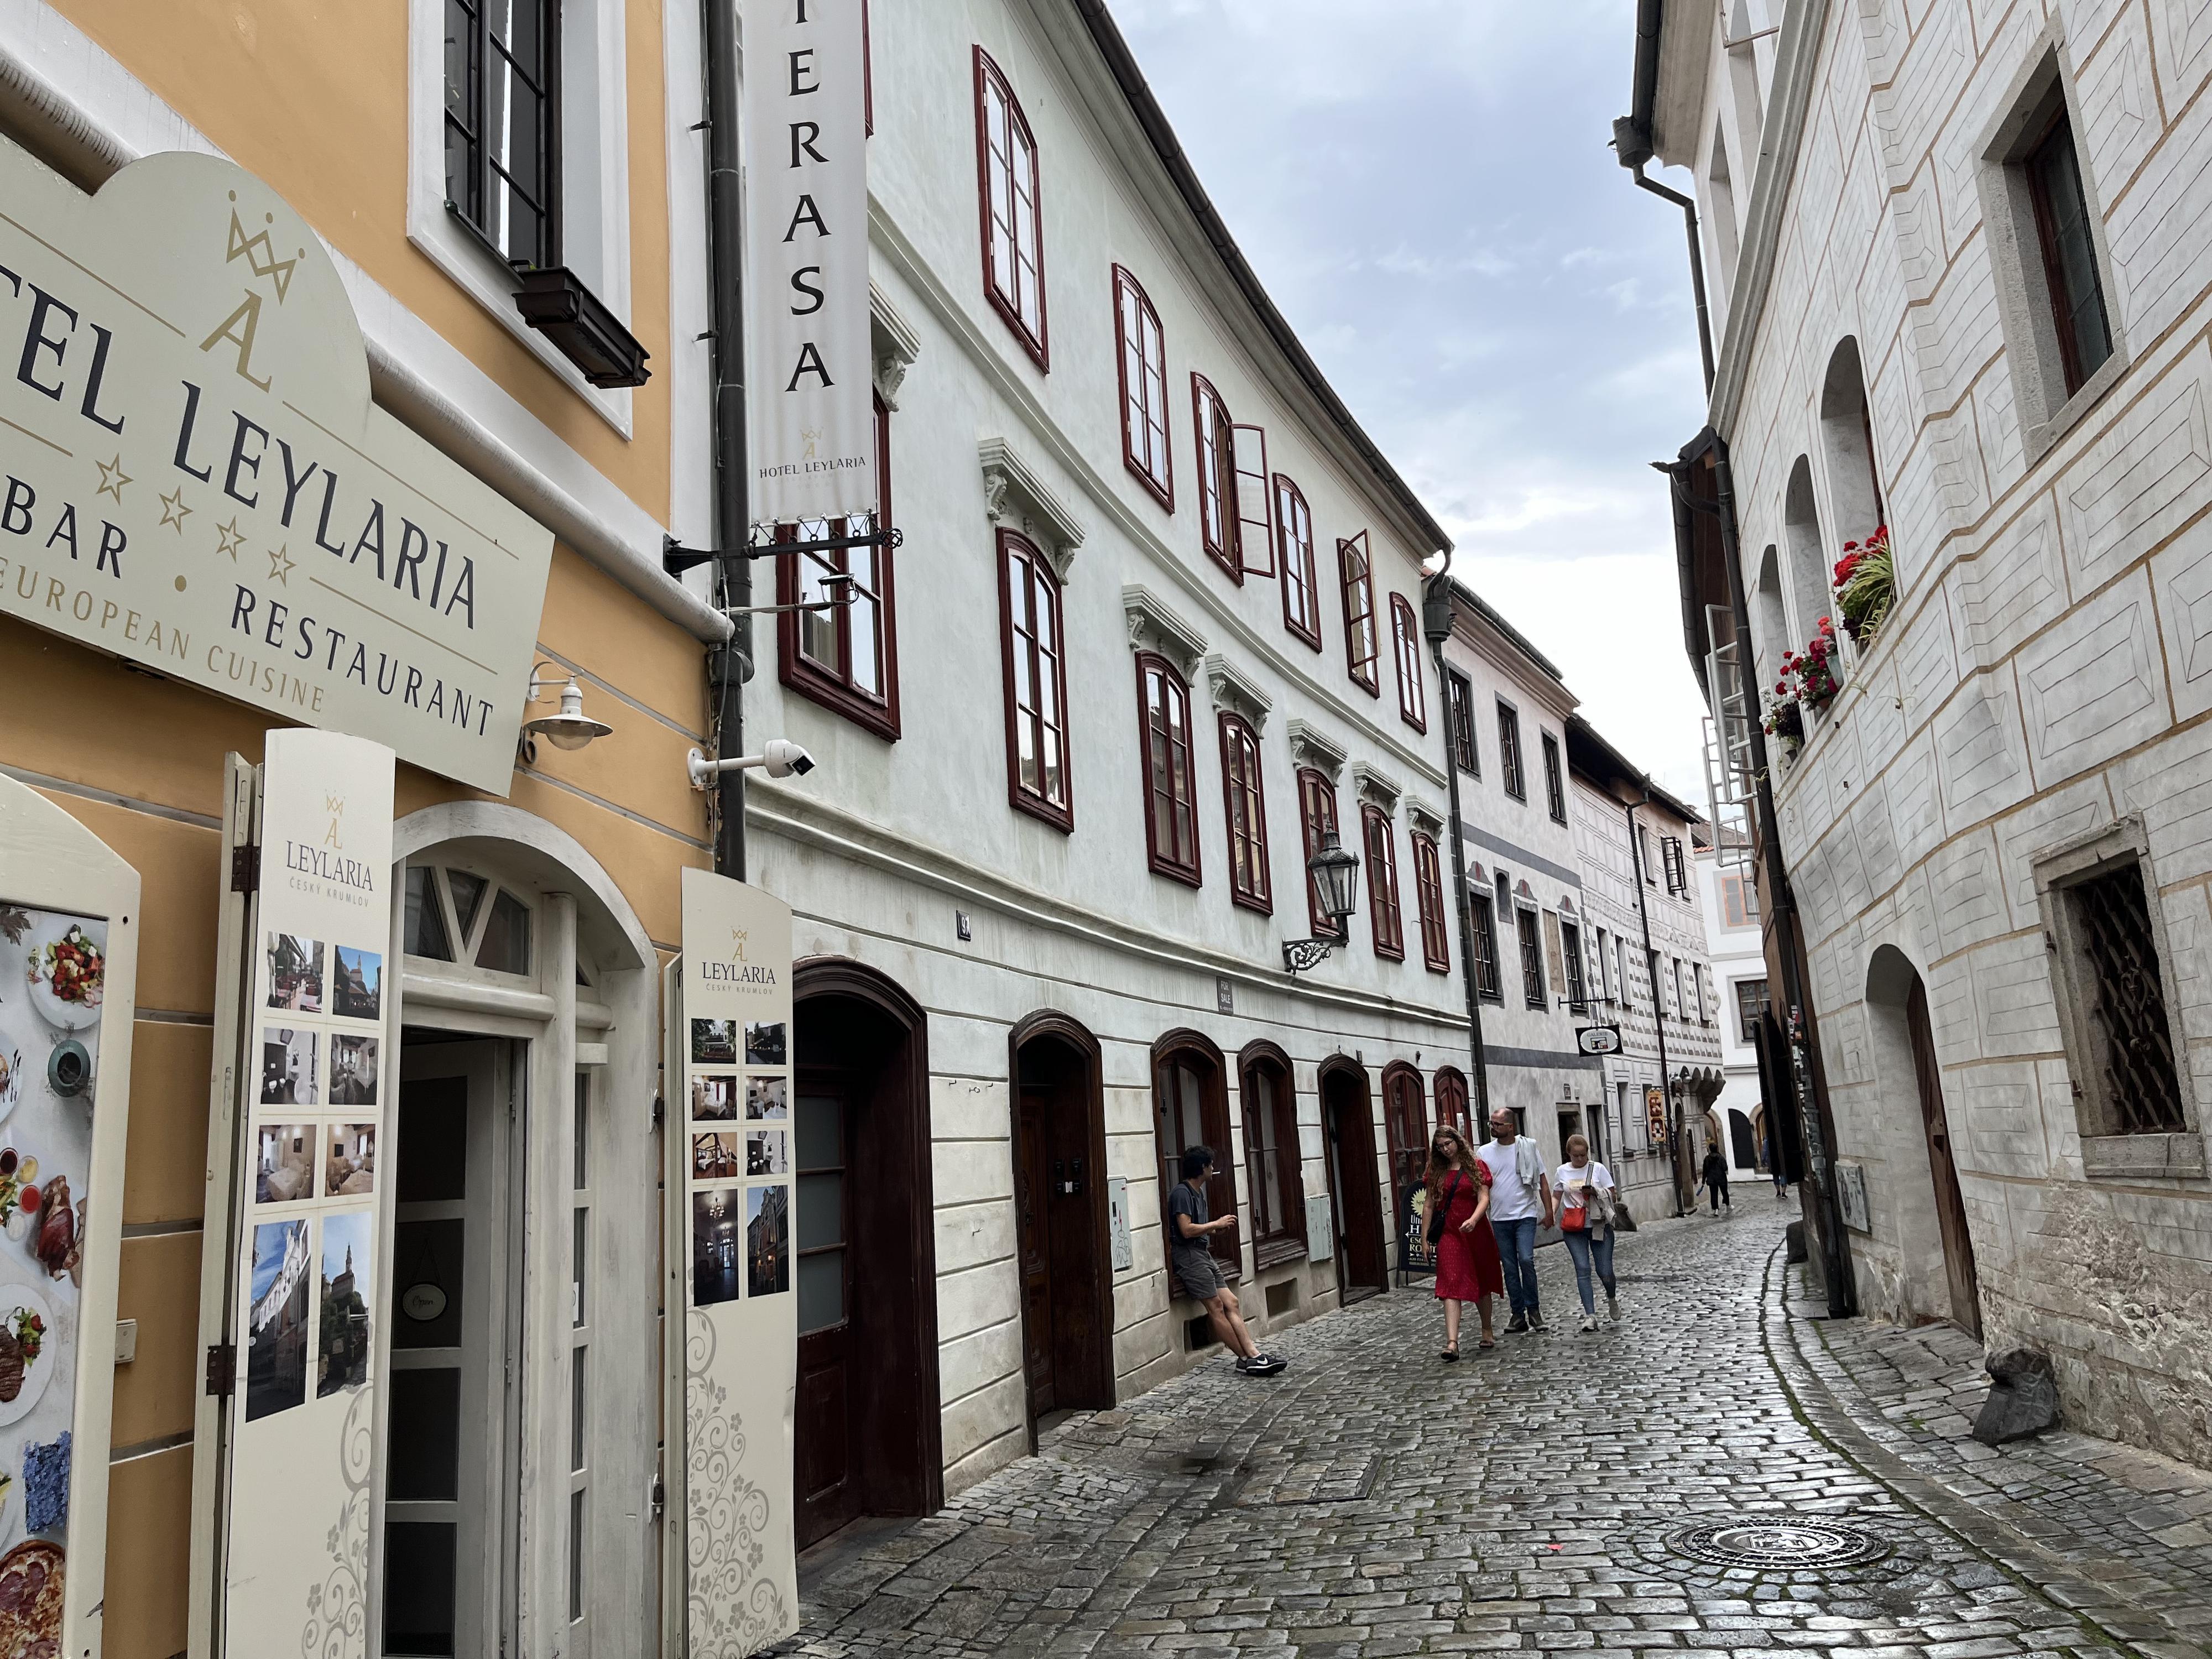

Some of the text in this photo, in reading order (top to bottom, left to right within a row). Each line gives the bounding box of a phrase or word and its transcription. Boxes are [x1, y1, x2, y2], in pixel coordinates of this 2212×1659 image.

[759, 456, 866, 478] HOTEL LEYLARIA
[174, 379, 474, 629] LEYLARIA
[1, 474, 493, 737] BAR RESTAURANT
[207, 644, 324, 713] CUISINE
[286, 840, 374, 891] LEYLARIA
[289, 876, 370, 907] ČESKÝ KRUMLOV
[702, 962, 776, 984] LEYLARIA
[706, 983, 774, 995] ČESKÝ KRUMLOV
[1221, 993, 1231, 1004] SALE
[412, 1295, 434, 1310] Open
